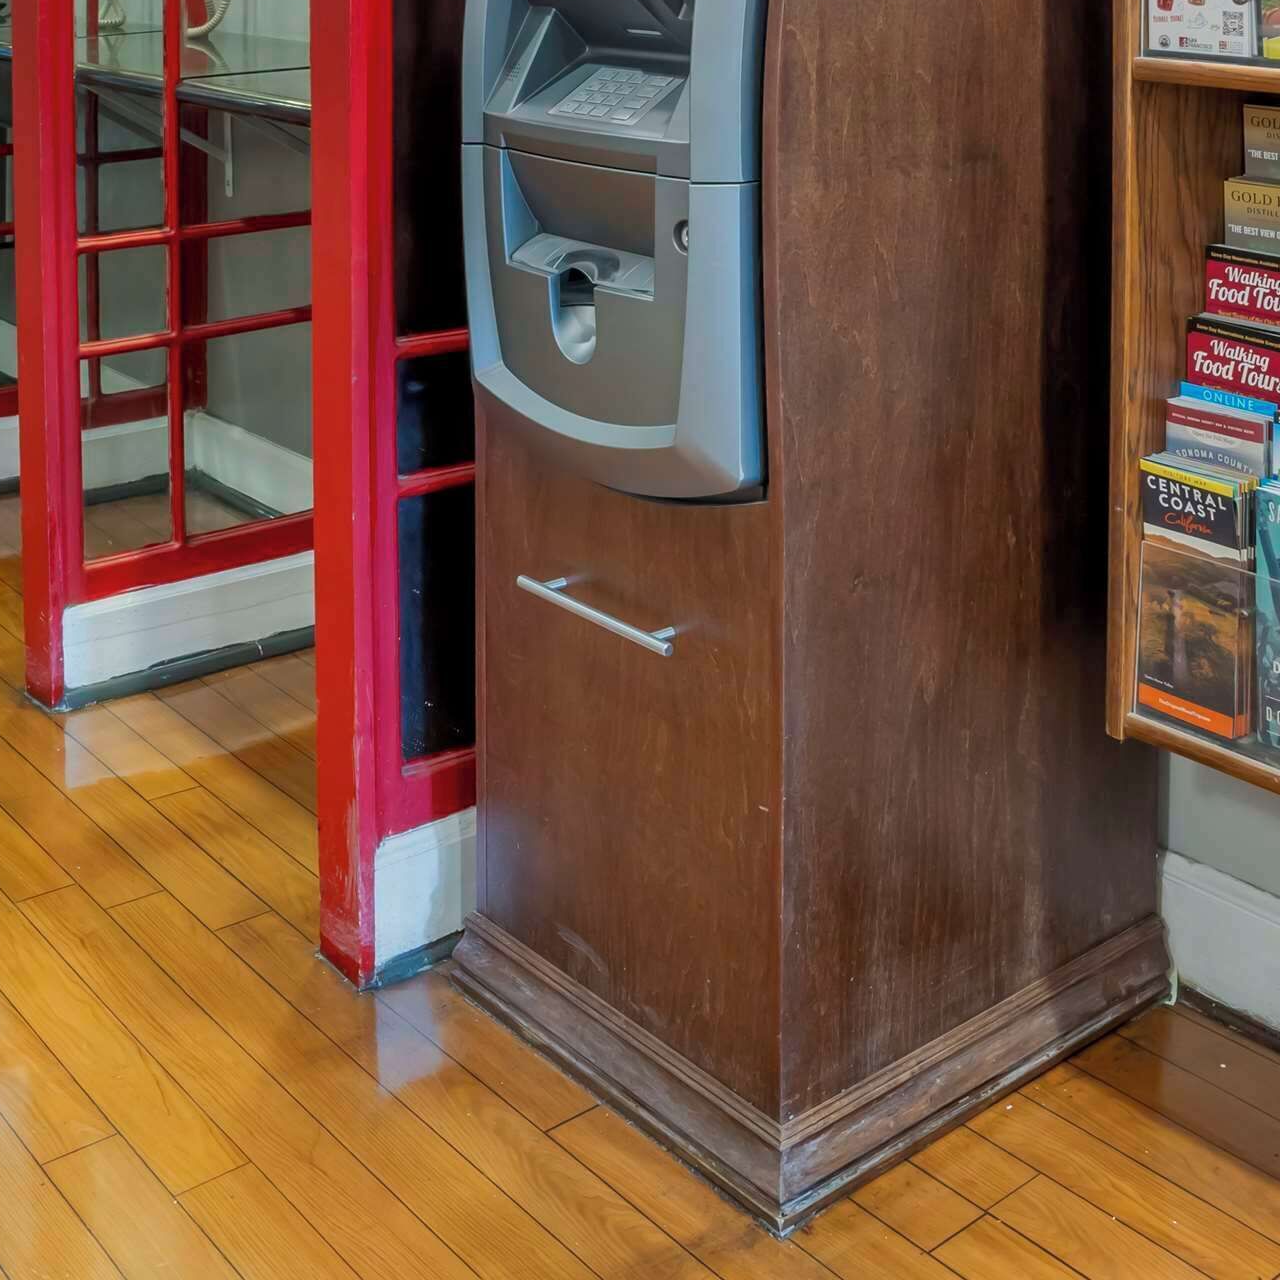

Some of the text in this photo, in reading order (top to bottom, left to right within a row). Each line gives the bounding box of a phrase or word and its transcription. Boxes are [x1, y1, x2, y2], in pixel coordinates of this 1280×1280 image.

[1231, 190, 1272, 206] GOLD
[1193, 351, 1235, 380] Food
[1210, 339, 1270, 371] Walking
[1146, 475, 1227, 511] CENTRAL
[1159, 492, 1217, 521] COAST
